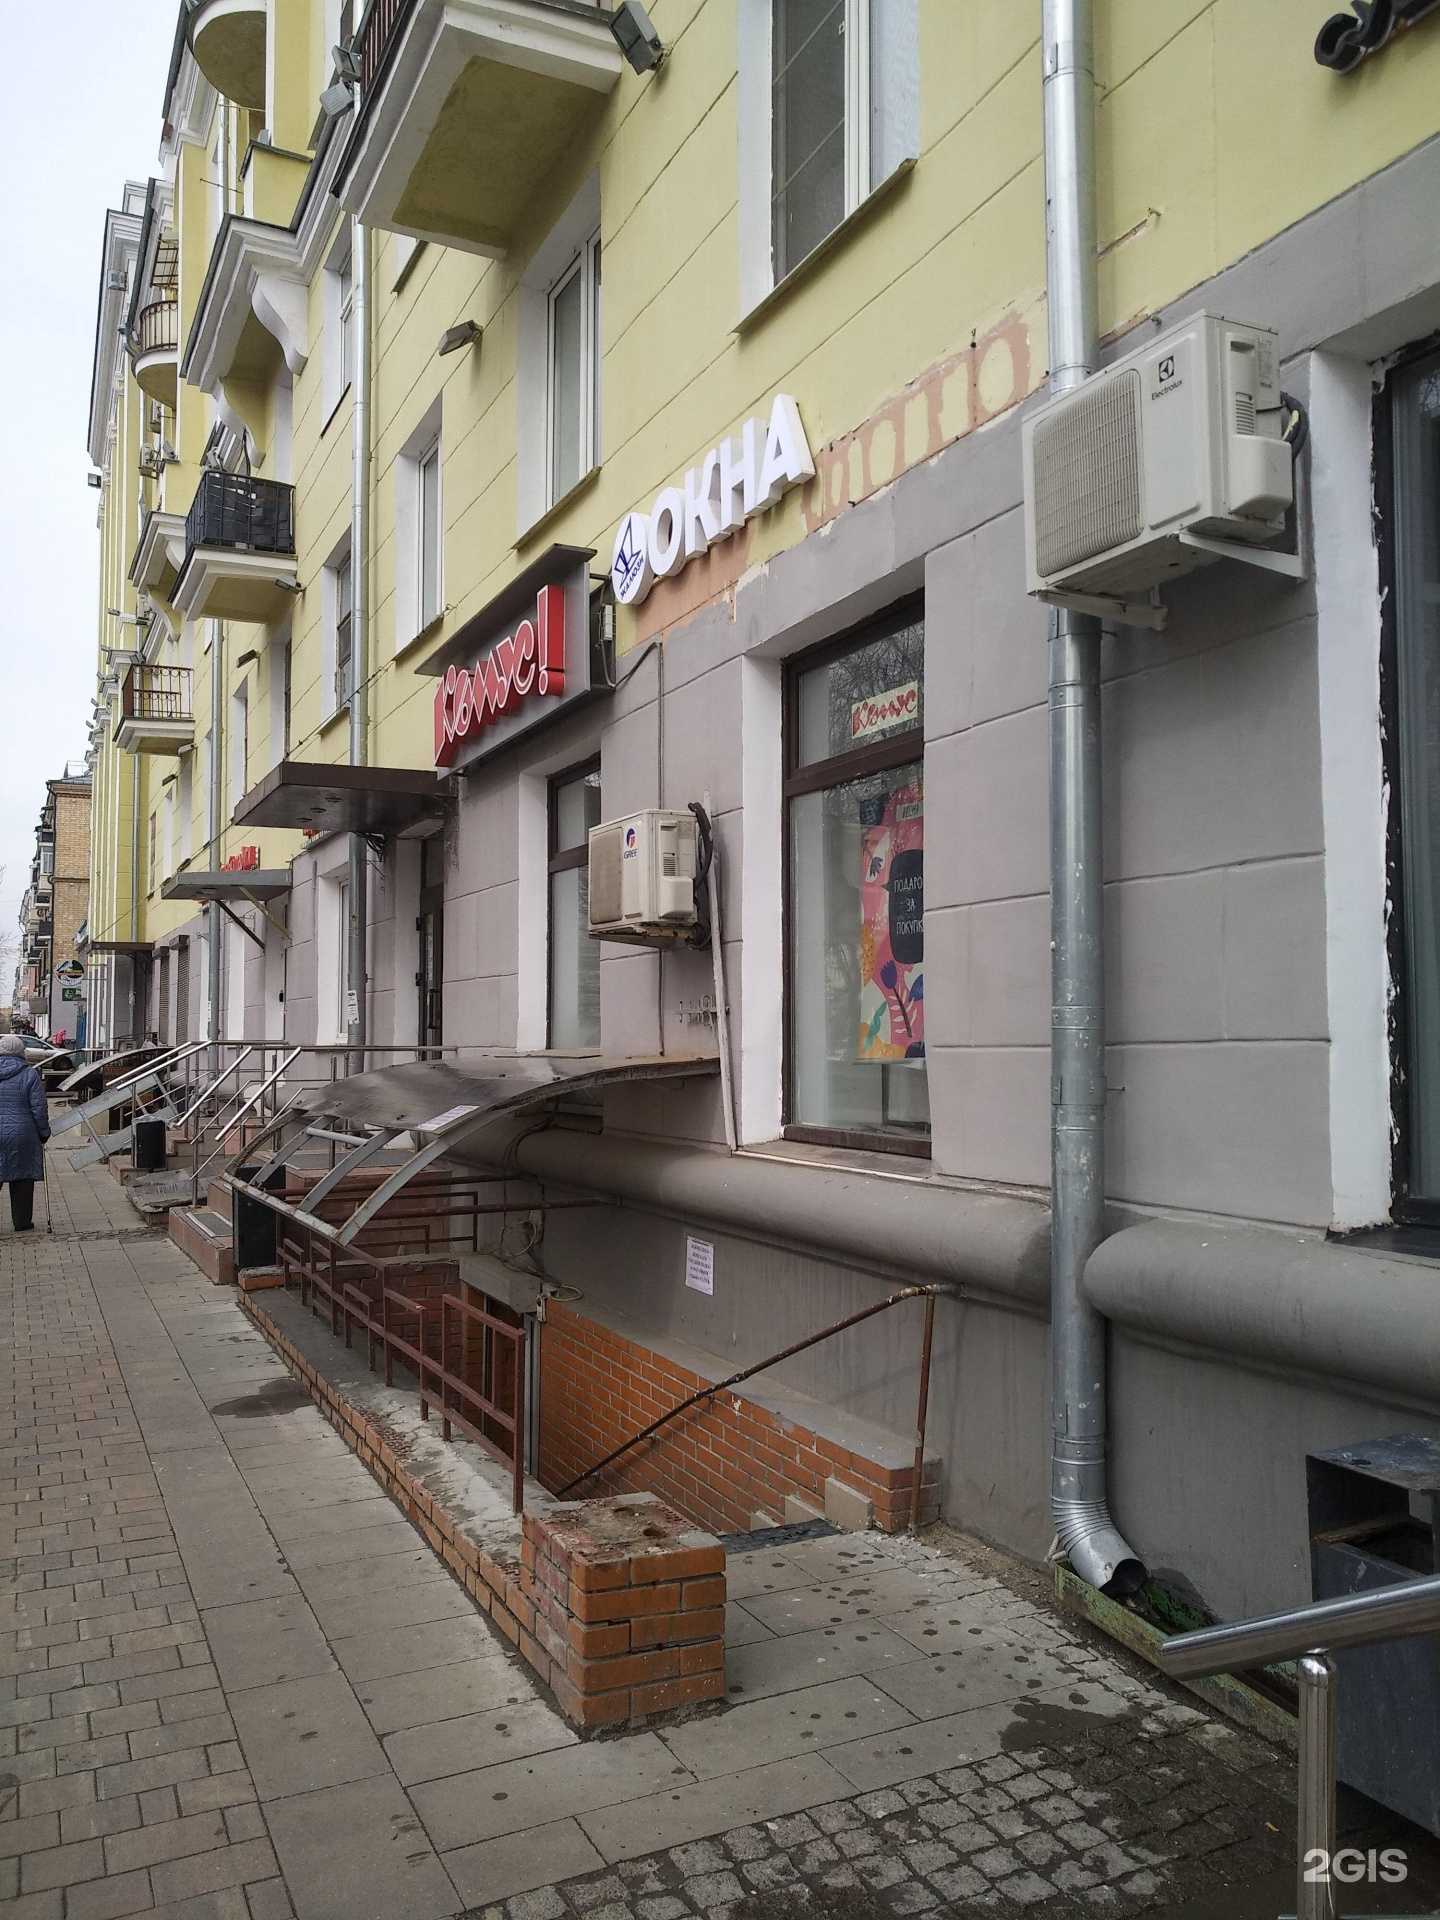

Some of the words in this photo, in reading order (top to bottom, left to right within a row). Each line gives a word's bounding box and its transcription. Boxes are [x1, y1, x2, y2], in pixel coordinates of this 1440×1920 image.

[647, 393, 817, 578] ОКНА
[433, 584, 565, 768] Комус!
[852, 688, 917, 737] Комус
[905, 897, 916, 913] ЗА
